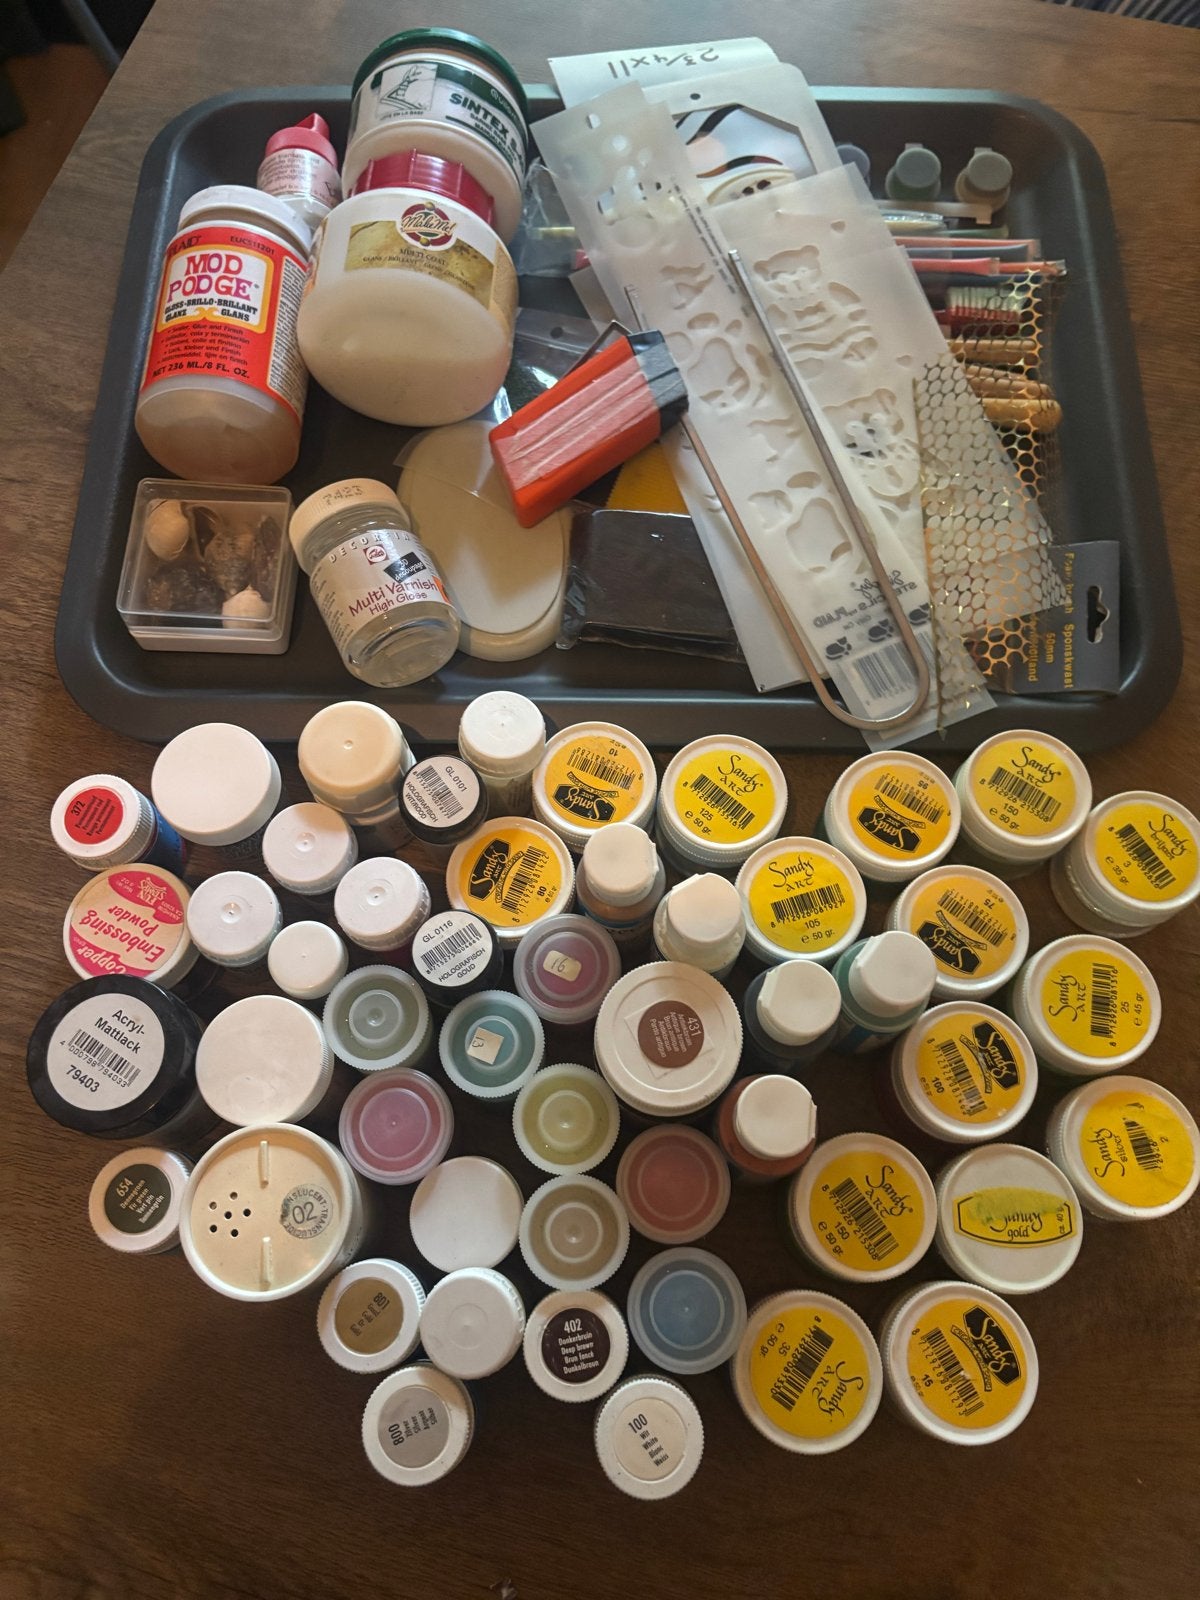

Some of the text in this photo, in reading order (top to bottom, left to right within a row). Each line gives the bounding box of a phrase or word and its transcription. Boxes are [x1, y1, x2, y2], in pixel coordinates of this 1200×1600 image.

[450, 93, 509, 137] SINTEX
[185, 253, 243, 276] MOD
[425, 254, 447, 265] COAT
[168, 275, 253, 302] PODGE
[165, 298, 258, 315] GLOSS BRILLO BRILLANT
[166, 309, 187, 322] GLANZ
[221, 309, 249, 321] GLANS
[224, 326, 243, 335] Finish
[222, 347, 241, 356] Finish
[152, 365, 166, 378] NET
[168, 362, 183, 371] 236
[216, 363, 229, 372] FL.
[233, 367, 250, 378] OZ.
[349, 579, 438, 617] Multi Varnish
[369, 591, 428, 616] High Gloss
[1046, 632, 1056, 663] 50mm
[1063, 624, 1075, 688] Sponskwast
[609, 748, 618, 756] 10
[718, 755, 760, 792] Sandy
[1012, 747, 1058, 783] Sandy
[445, 766, 467, 792] GL 0101
[917, 780, 929, 789] 95
[71, 801, 86, 816] 372
[406, 782, 438, 822] HOLOGRAFISCH
[406, 793, 427, 819] WIT/ROOD
[565, 788, 599, 820] Sandy
[1003, 803, 1019, 816] 150
[699, 808, 713, 821] 125
[999, 814, 1010, 823] 50
[694, 818, 711, 835] 50 gr.
[869, 812, 904, 849] Sandy
[1148, 814, 1189, 856] Sandy
[472, 849, 507, 893] Sandy
[768, 854, 814, 887] Sandy
[1113, 865, 1123, 875] 35
[537, 886, 547, 896] 80
[983, 899, 995, 909] 75
[108, 906, 159, 937] Powder
[805, 919, 820, 929] 105
[79, 910, 165, 963] Embossing
[423, 920, 453, 942] GL 0116
[813, 929, 835, 940] 50 gr.
[928, 928, 963, 969] Sandy
[77, 946, 127, 974] Copper
[439, 947, 485, 982] HOLOGRAFISCH
[457, 963, 476, 978] GOUD
[1048, 975, 1078, 1022] Sandy
[1121, 1001, 1129, 1013] 25
[1134, 1004, 1142, 1015] 45
[112, 1010, 144, 1034] Acryl-
[687, 1018, 702, 1036] 431
[95, 1017, 141, 1054] Mattlack
[976, 1032, 1016, 1078] Sandy
[66, 1065, 100, 1093] 79403
[932, 1076, 945, 1093] 100
[1088, 1128, 1125, 1177] Sandy
[1113, 1134, 1128, 1162] silver
[116, 1178, 133, 1196] 654
[865, 1165, 911, 1217] Sandy
[293, 1202, 318, 1224] 02
[826, 1233, 837, 1245] 50
[834, 1222, 850, 1240] 150
[1008, 1225, 1030, 1242] gold
[374, 1292, 390, 1310] 801
[564, 1318, 583, 1333] 402
[558, 1332, 593, 1346] Donkerbruin
[767, 1334, 778, 1346] 50
[968, 1317, 1015, 1373] Sandy
[561, 1342, 594, 1355] Deep brown
[779, 1342, 790, 1356] 35
[563, 1360, 599, 1374] Dunkelbraun
[565, 1355, 578, 1364] Brun
[818, 1361, 864, 1417] Sandy
[922, 1374, 933, 1387] 15
[628, 1414, 648, 1433] 100
[388, 1423, 404, 1446] 800
[640, 1430, 650, 1440] Wit
[642, 1436, 658, 1450] White
[649, 1446, 664, 1459] Blanc
[654, 1453, 669, 1467] Weiss
